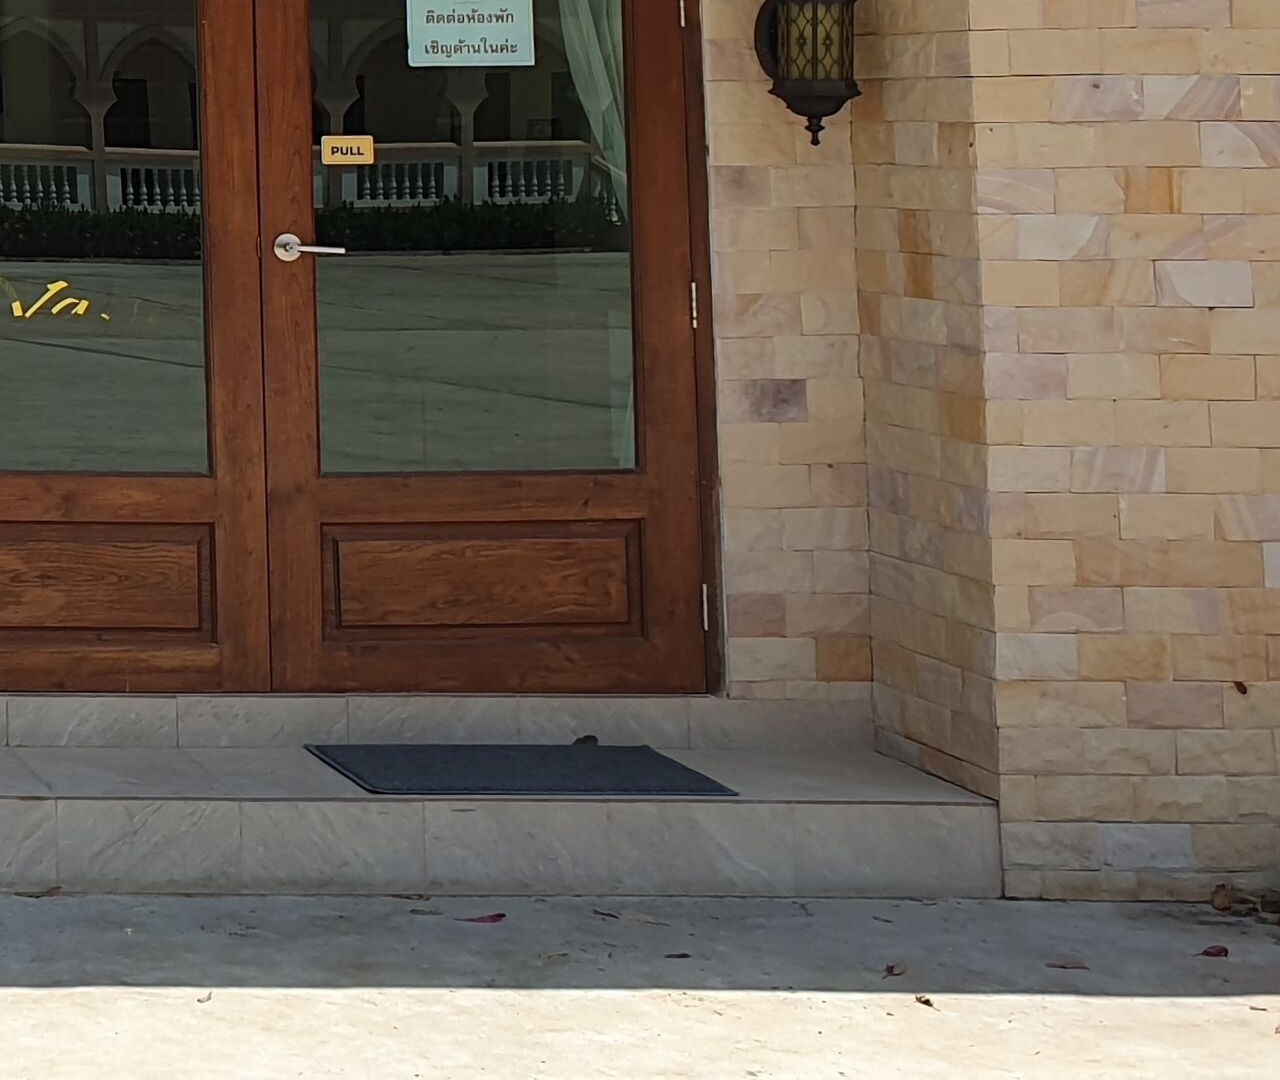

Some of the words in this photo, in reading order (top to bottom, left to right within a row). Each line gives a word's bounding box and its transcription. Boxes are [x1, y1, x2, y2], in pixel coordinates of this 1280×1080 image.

[425, 8, 514, 24] ติดต่อห้องพัก
[424, 37, 518, 57] เชิญด้านในค่ะ
[330, 145, 365, 156] PULL
